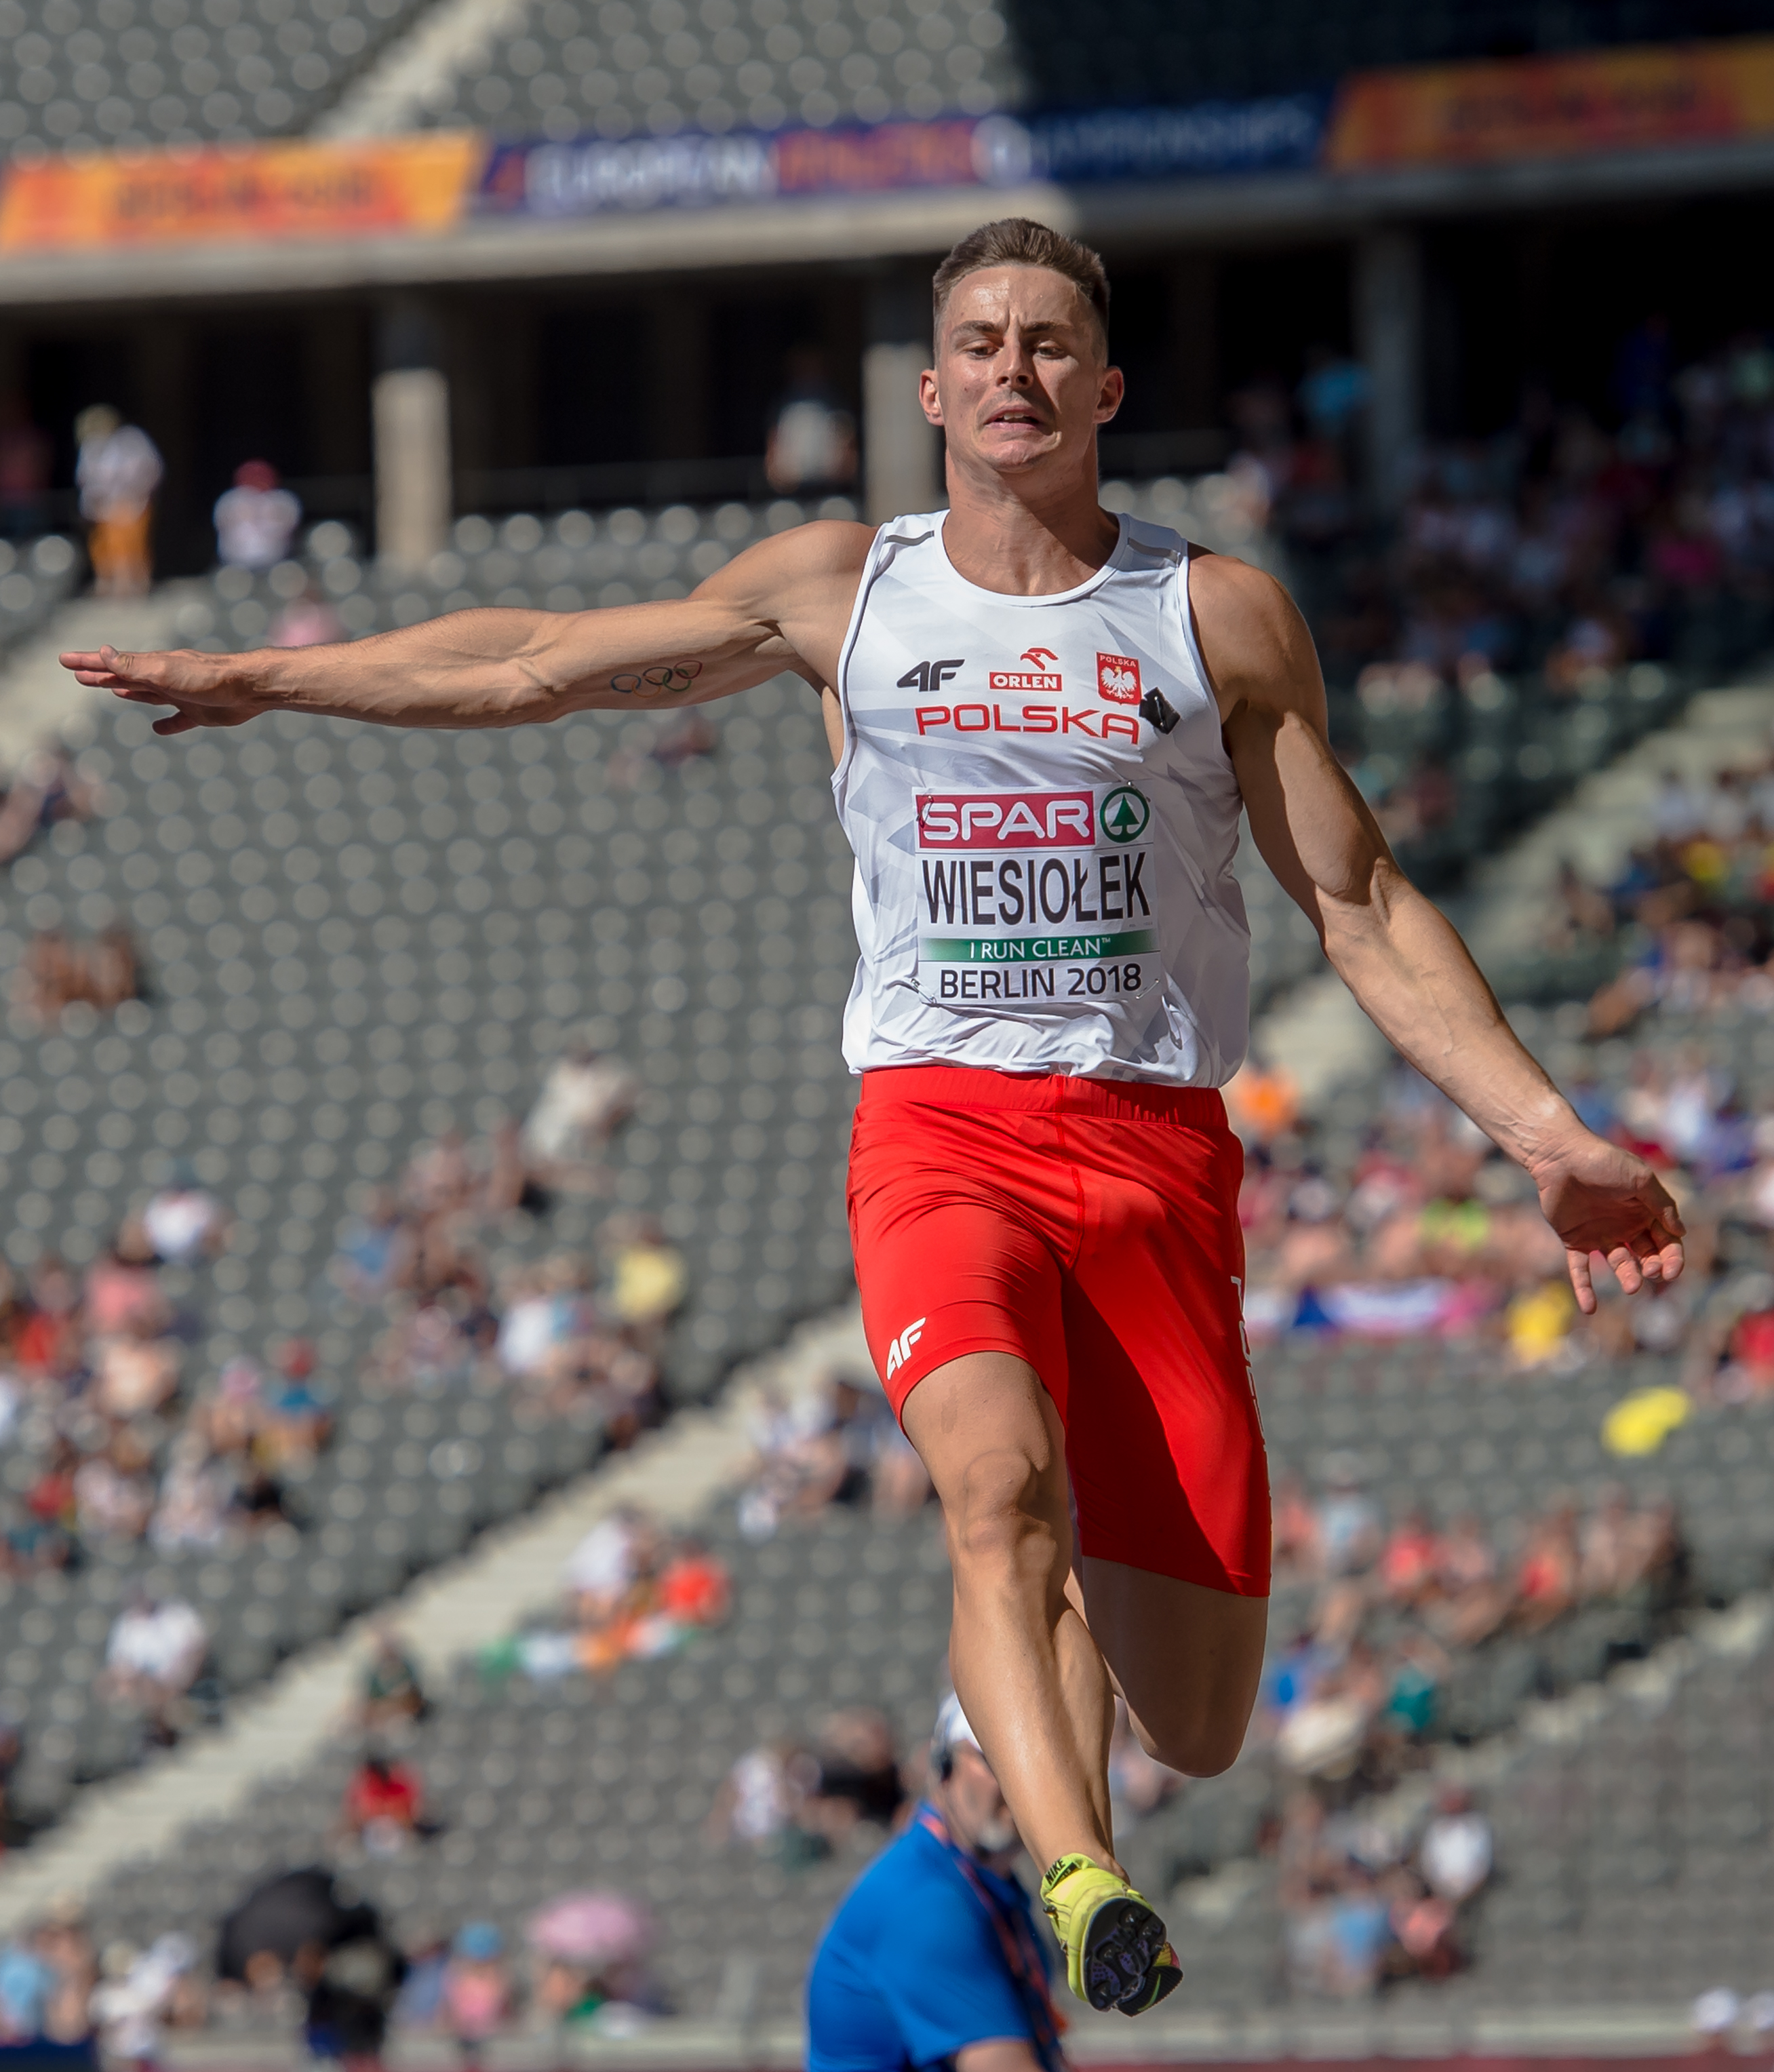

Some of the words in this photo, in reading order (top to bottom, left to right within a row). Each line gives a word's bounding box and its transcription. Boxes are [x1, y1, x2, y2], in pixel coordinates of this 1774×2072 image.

[1099, 654, 1137, 667] POLSKA
[993, 674, 1057, 689] ORLEN
[914, 703, 1140, 745] POLSKA
[921, 799, 1090, 841] SPAR
[921, 851, 1151, 926] WIESIOŁEK
[970, 941, 975, 959] I
[981, 941, 1025, 960] RUN
[940, 968, 1055, 999] BERLIN
[1067, 962, 1142, 996] 2018
[1045, 1858, 1066, 1886] NIKE
